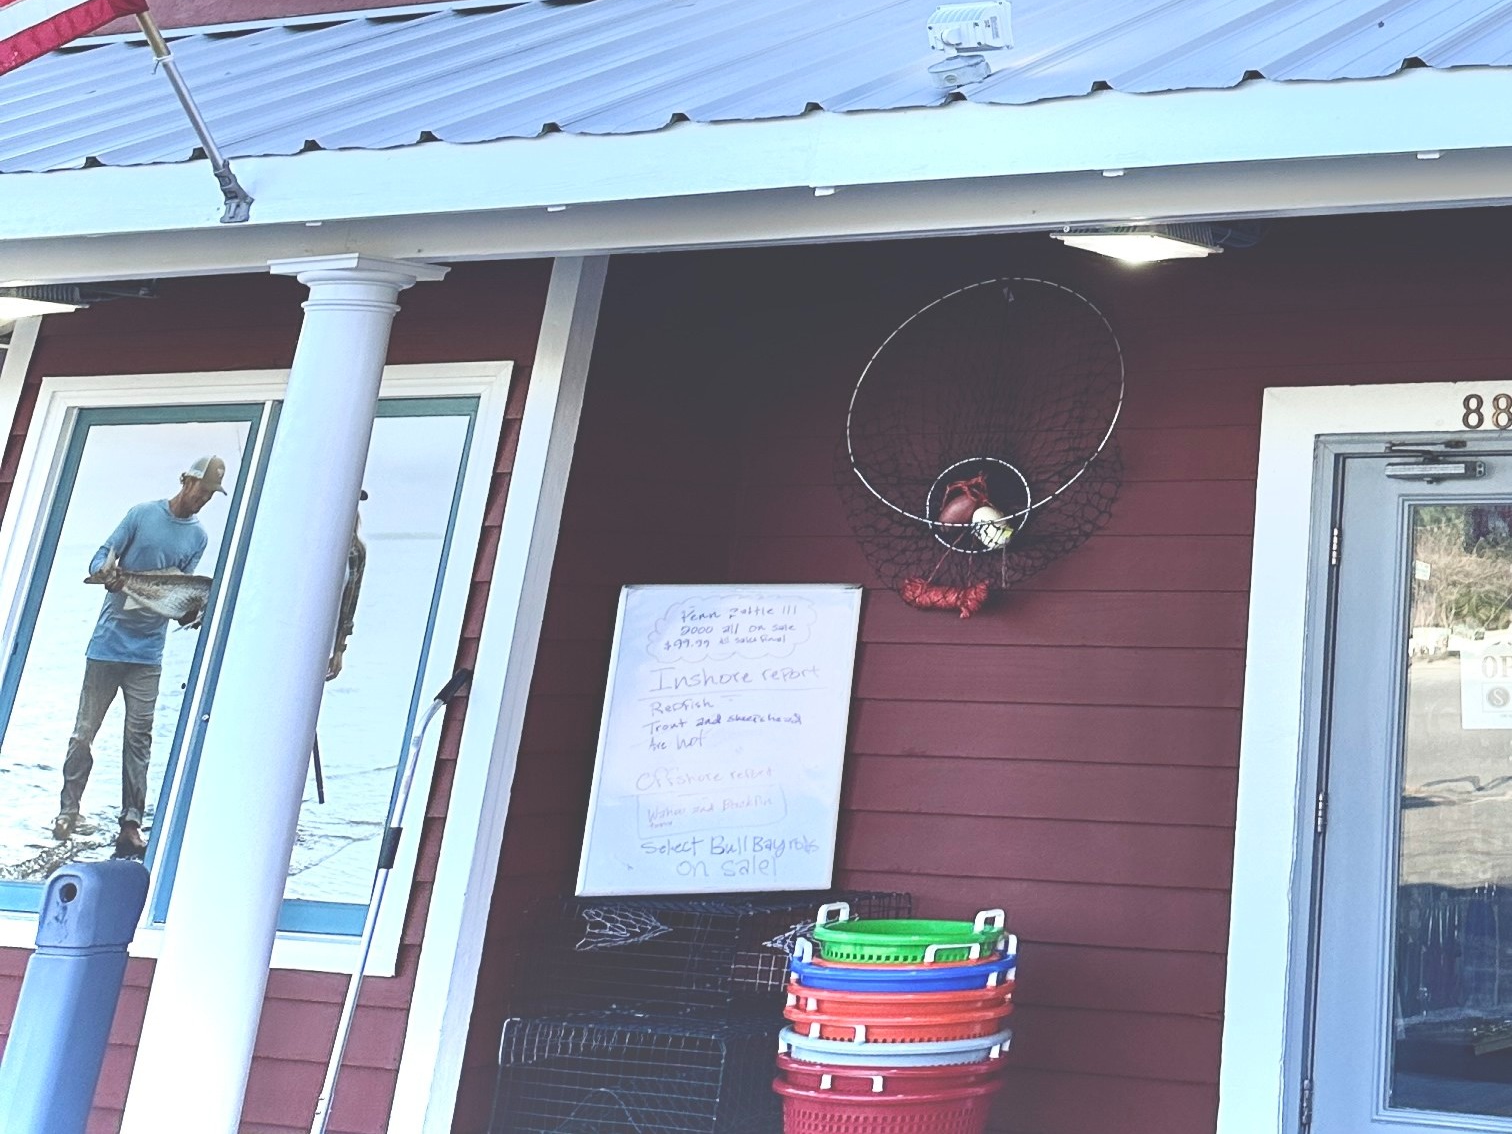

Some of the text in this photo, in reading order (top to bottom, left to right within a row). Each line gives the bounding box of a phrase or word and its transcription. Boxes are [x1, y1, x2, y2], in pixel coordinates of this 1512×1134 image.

[648, 666, 753, 693] Inshore
[710, 835, 748, 856] Bull
[752, 836, 786, 858] Bay
[676, 859, 710, 878] on
